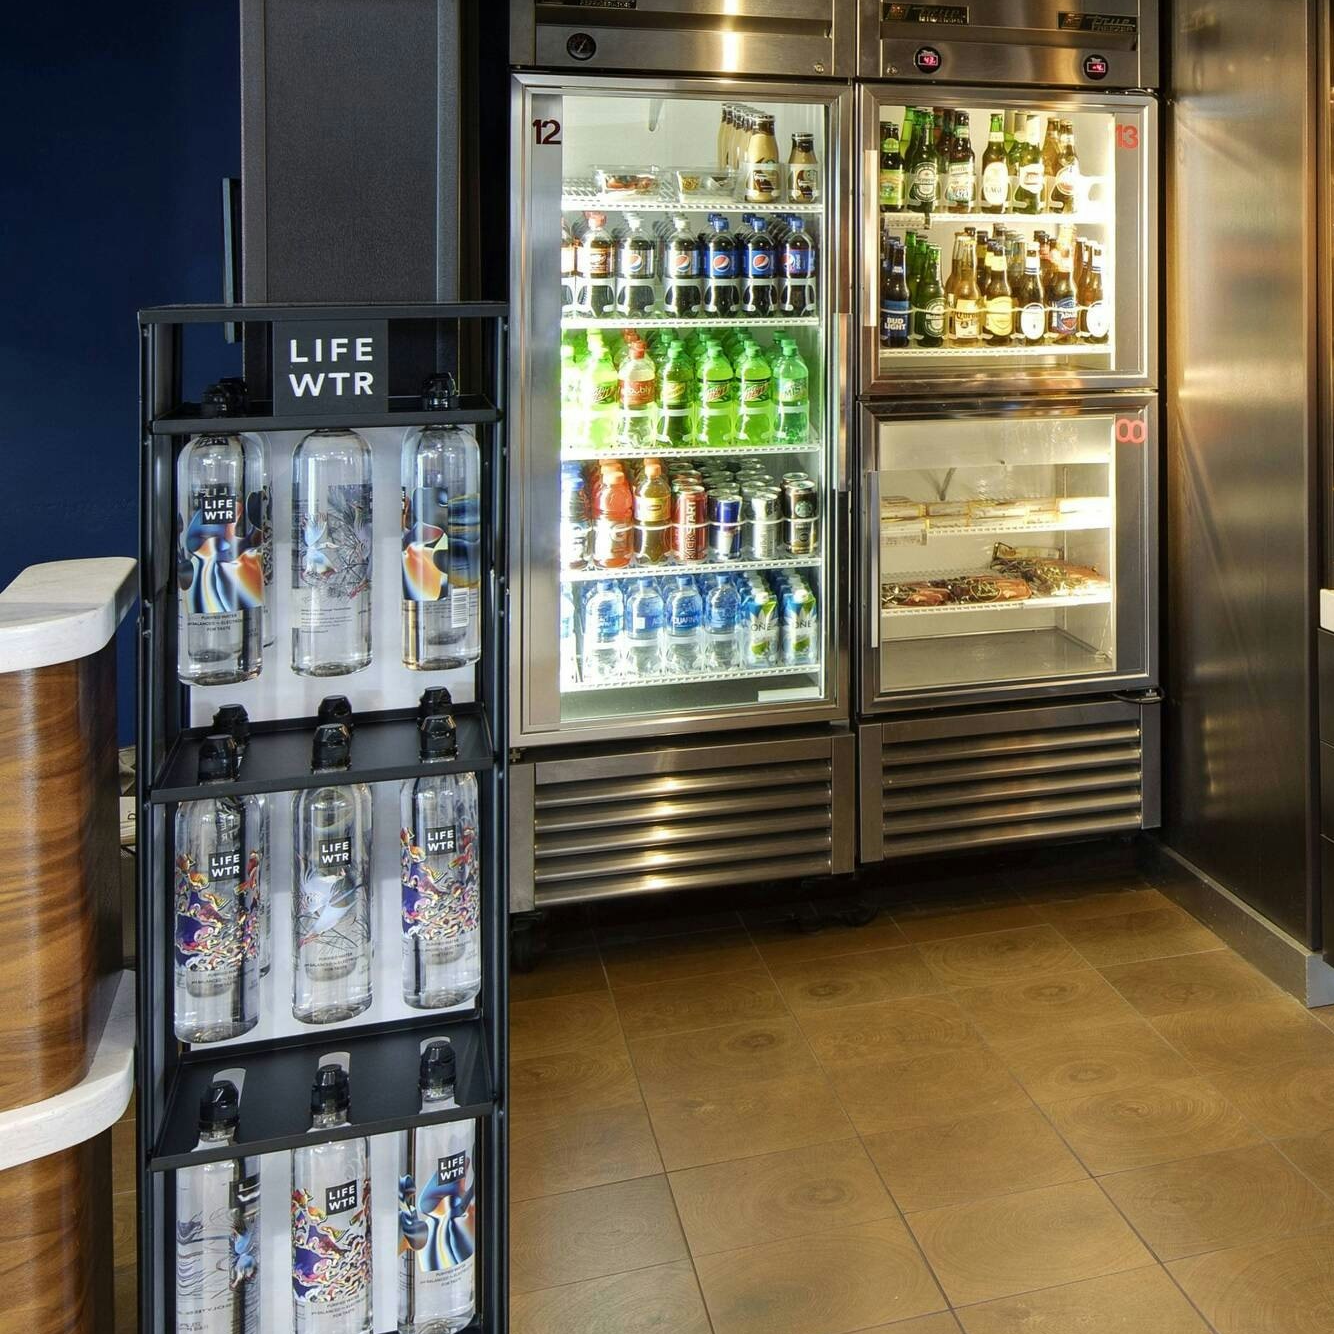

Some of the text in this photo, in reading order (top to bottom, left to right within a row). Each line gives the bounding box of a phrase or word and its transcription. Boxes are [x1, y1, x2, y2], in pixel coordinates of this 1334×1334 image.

[532, 119, 562, 145] 12
[1115, 122, 1140, 149] 13
[884, 323, 906, 331] LIGHT
[290, 338, 373, 363] LIFE
[288, 371, 374, 397] WTR
[204, 499, 233, 509] LIFE
[204, 510, 234, 520] WTR
[428, 829, 454, 841] LIFE
[322, 841, 349, 853] LIFE
[427, 841, 454, 852] WTR
[211, 854, 240, 866] LIFE
[322, 852, 349, 864] WTR
[211, 866, 240, 877] WTR
[440, 1155, 465, 1171] LIFE
[440, 1166, 464, 1181] WTR
[329, 1184, 355, 1200] LIFE
[328, 1196, 355, 1211] WTR
